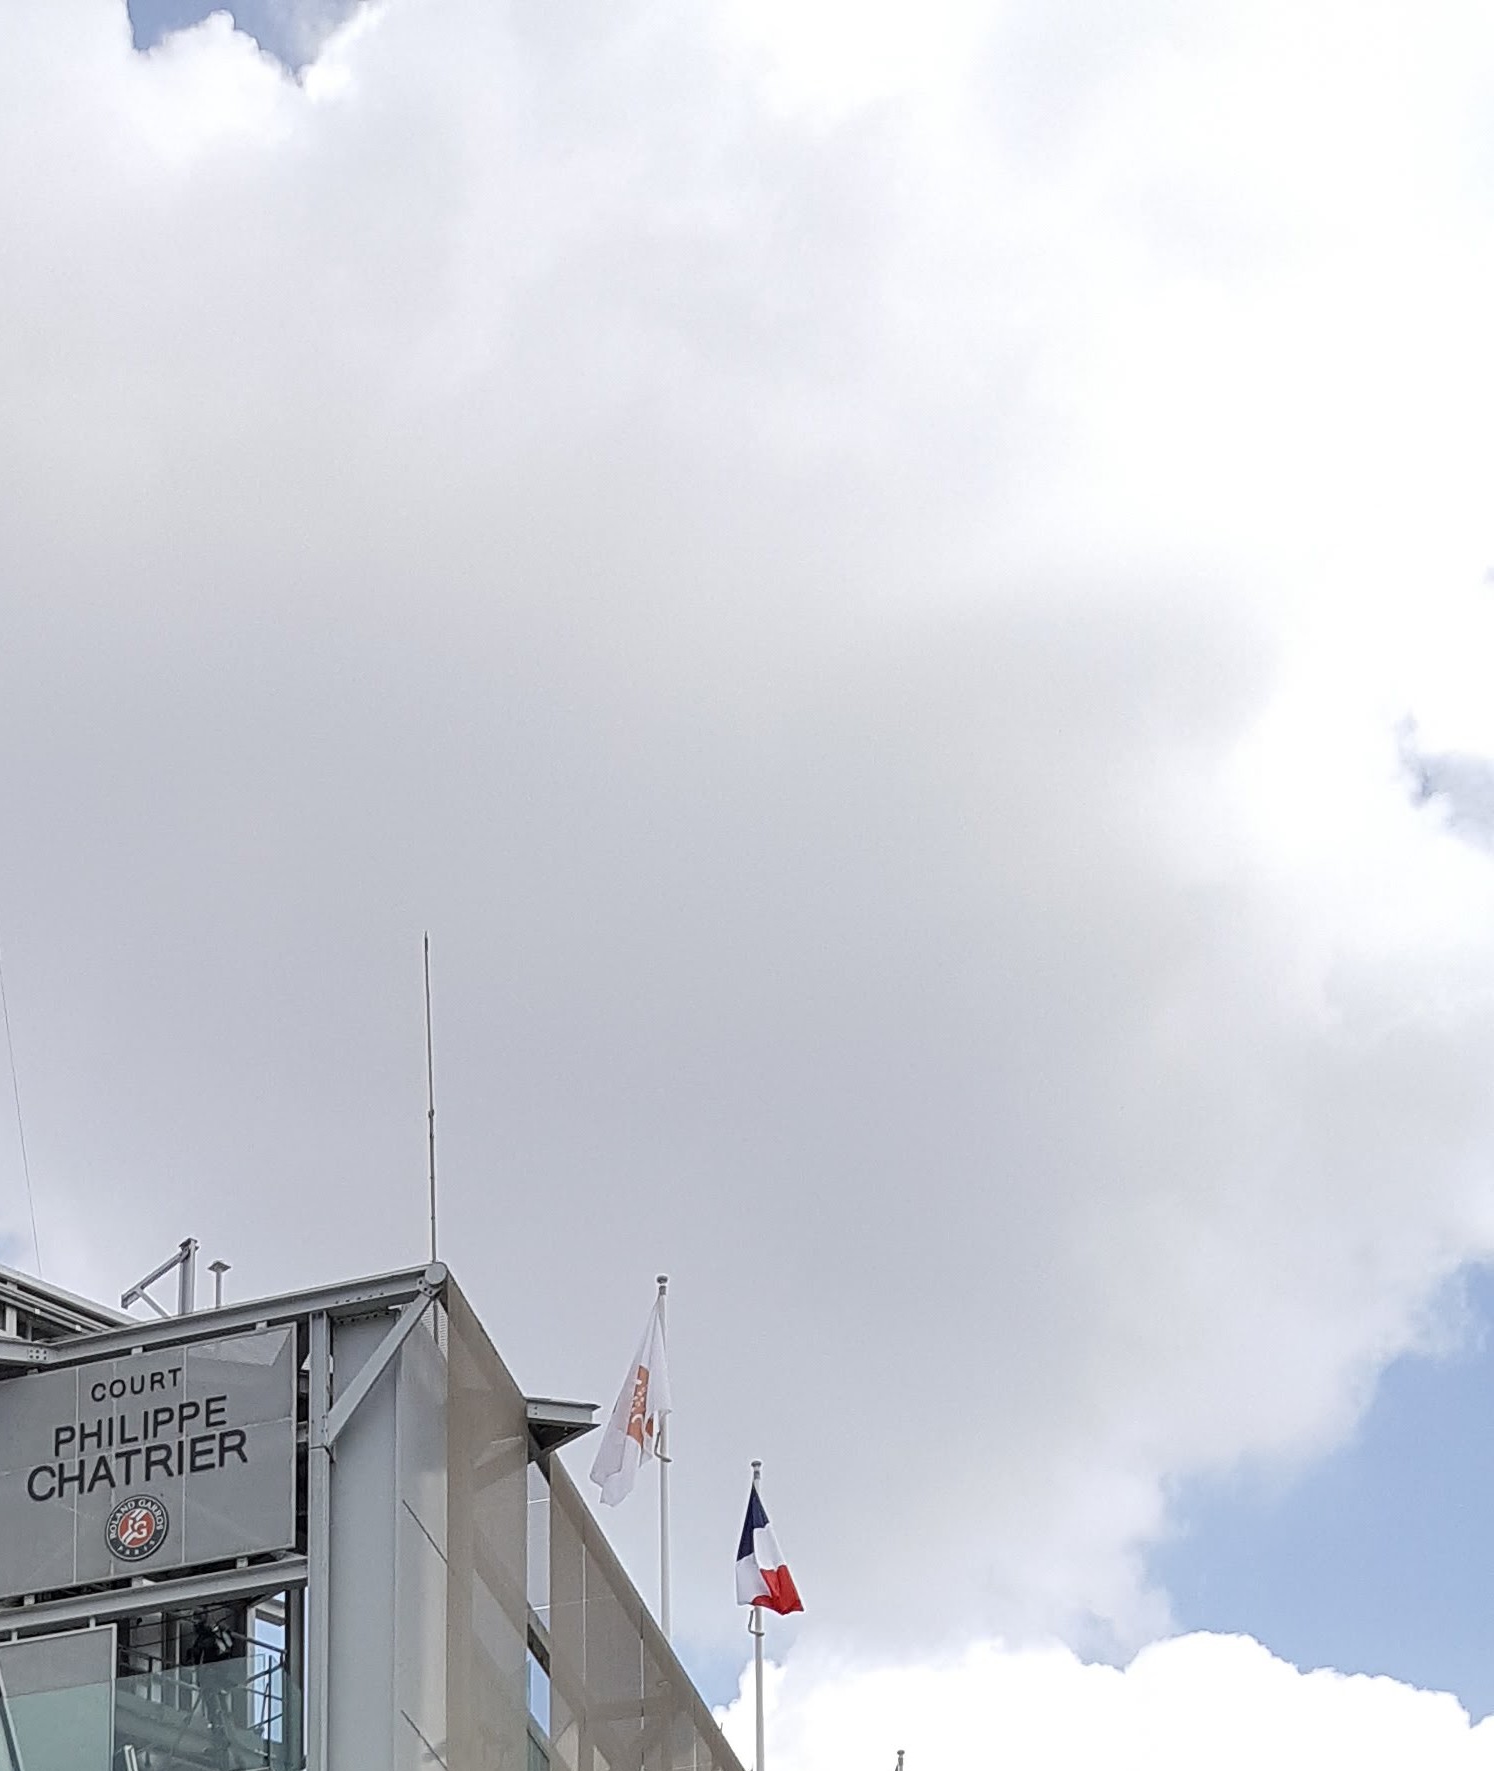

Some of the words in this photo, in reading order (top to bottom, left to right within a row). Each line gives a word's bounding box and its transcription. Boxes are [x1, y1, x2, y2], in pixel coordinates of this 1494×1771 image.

[91, 1367, 182, 1402] COURT
[54, 1395, 227, 1457] PHILIPPE
[27, 1429, 248, 1502] CHATRIER
[109, 1501, 136, 1540] ROLAND
